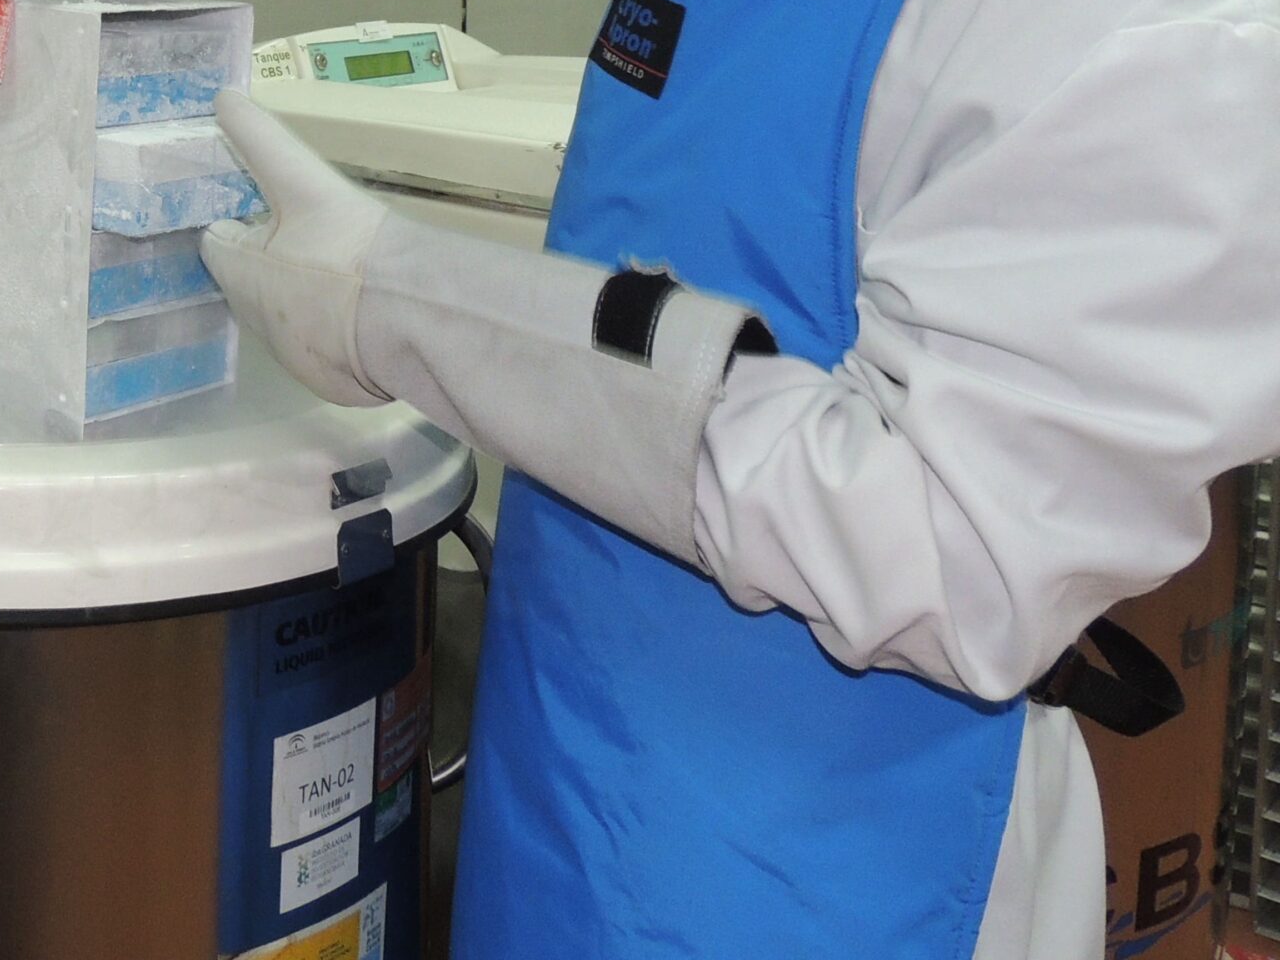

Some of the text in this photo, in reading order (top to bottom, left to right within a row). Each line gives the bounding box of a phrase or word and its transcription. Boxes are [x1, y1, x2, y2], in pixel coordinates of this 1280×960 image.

[253, 51, 291, 64] Tanque
[261, 65, 292, 78] CBS 1
[298, 762, 355, 805] TAN-02
